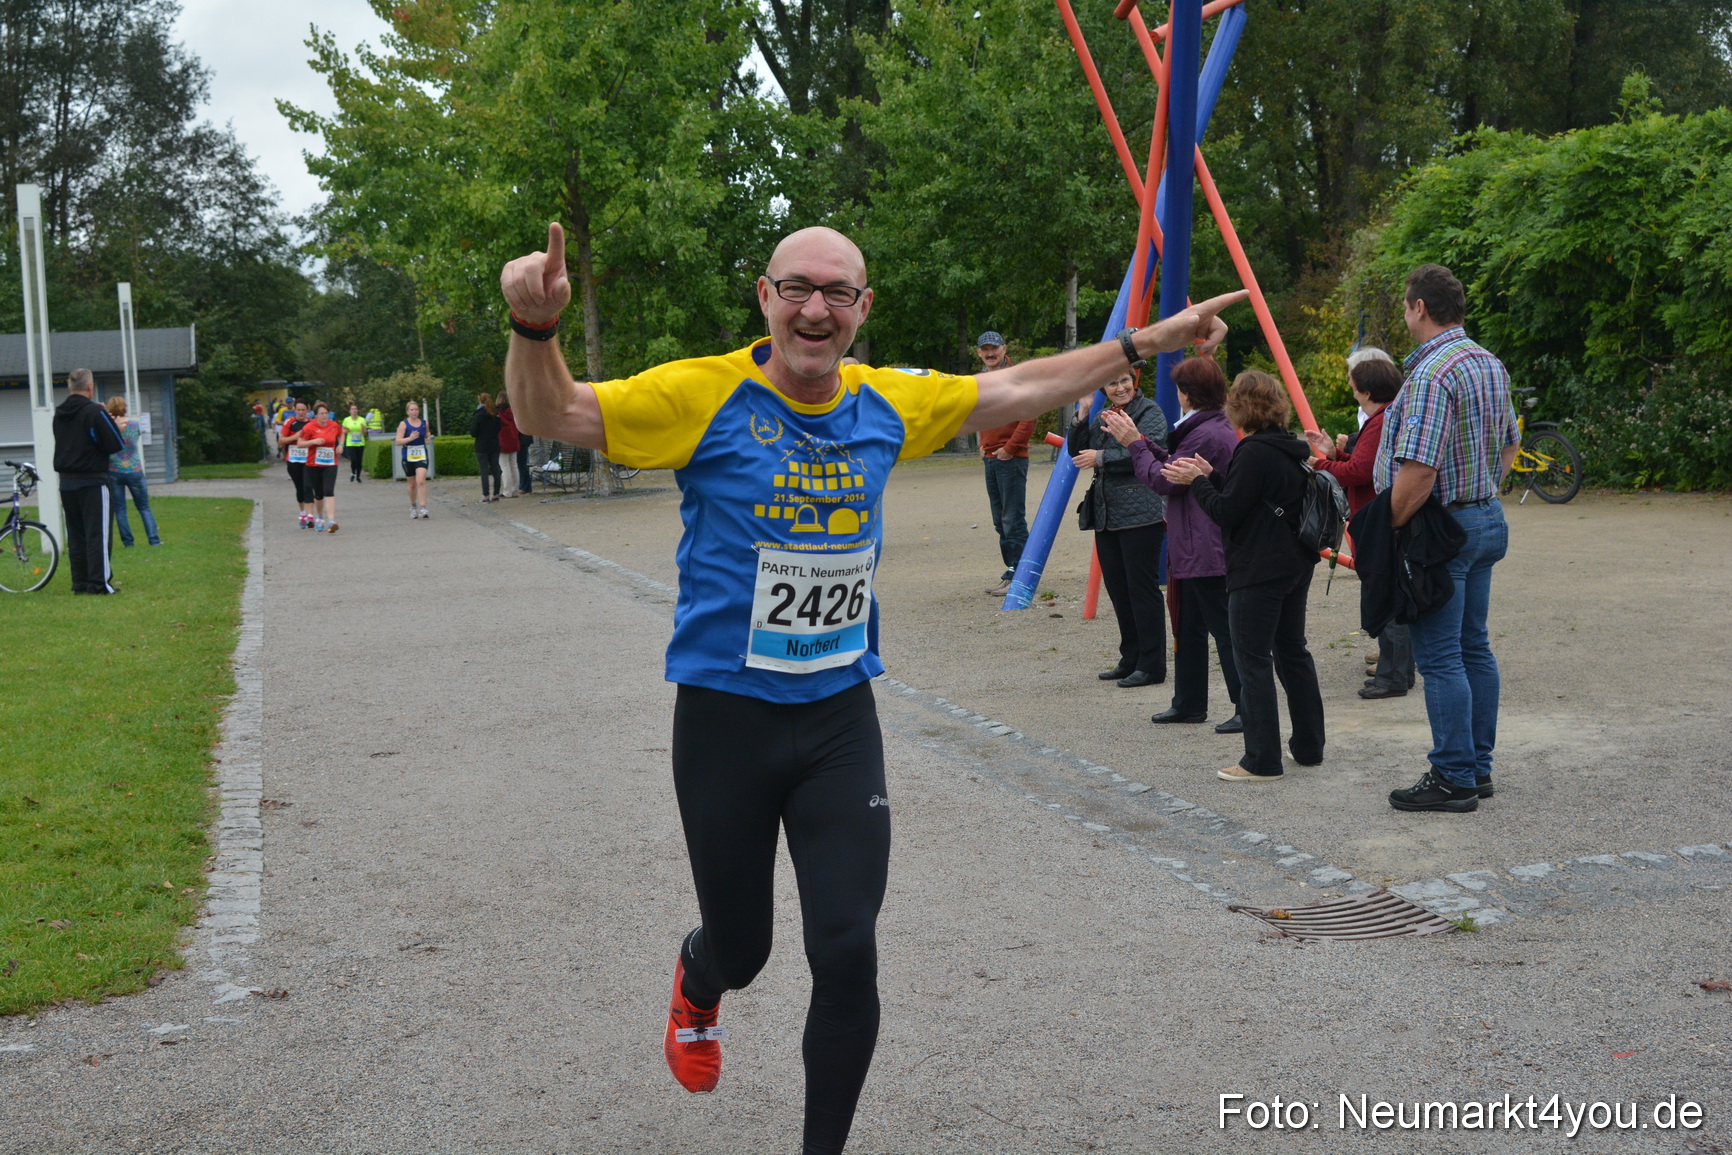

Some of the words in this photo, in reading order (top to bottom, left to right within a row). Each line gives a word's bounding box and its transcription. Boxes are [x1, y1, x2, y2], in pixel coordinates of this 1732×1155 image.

[773, 493, 842, 504] 21.September
[843, 493, 866, 503] 2014
[761, 561, 807, 578] PARTL
[810, 564, 864, 578] Neumarkt
[767, 578, 866, 627] 2426
[786, 635, 840, 657] Norbert
